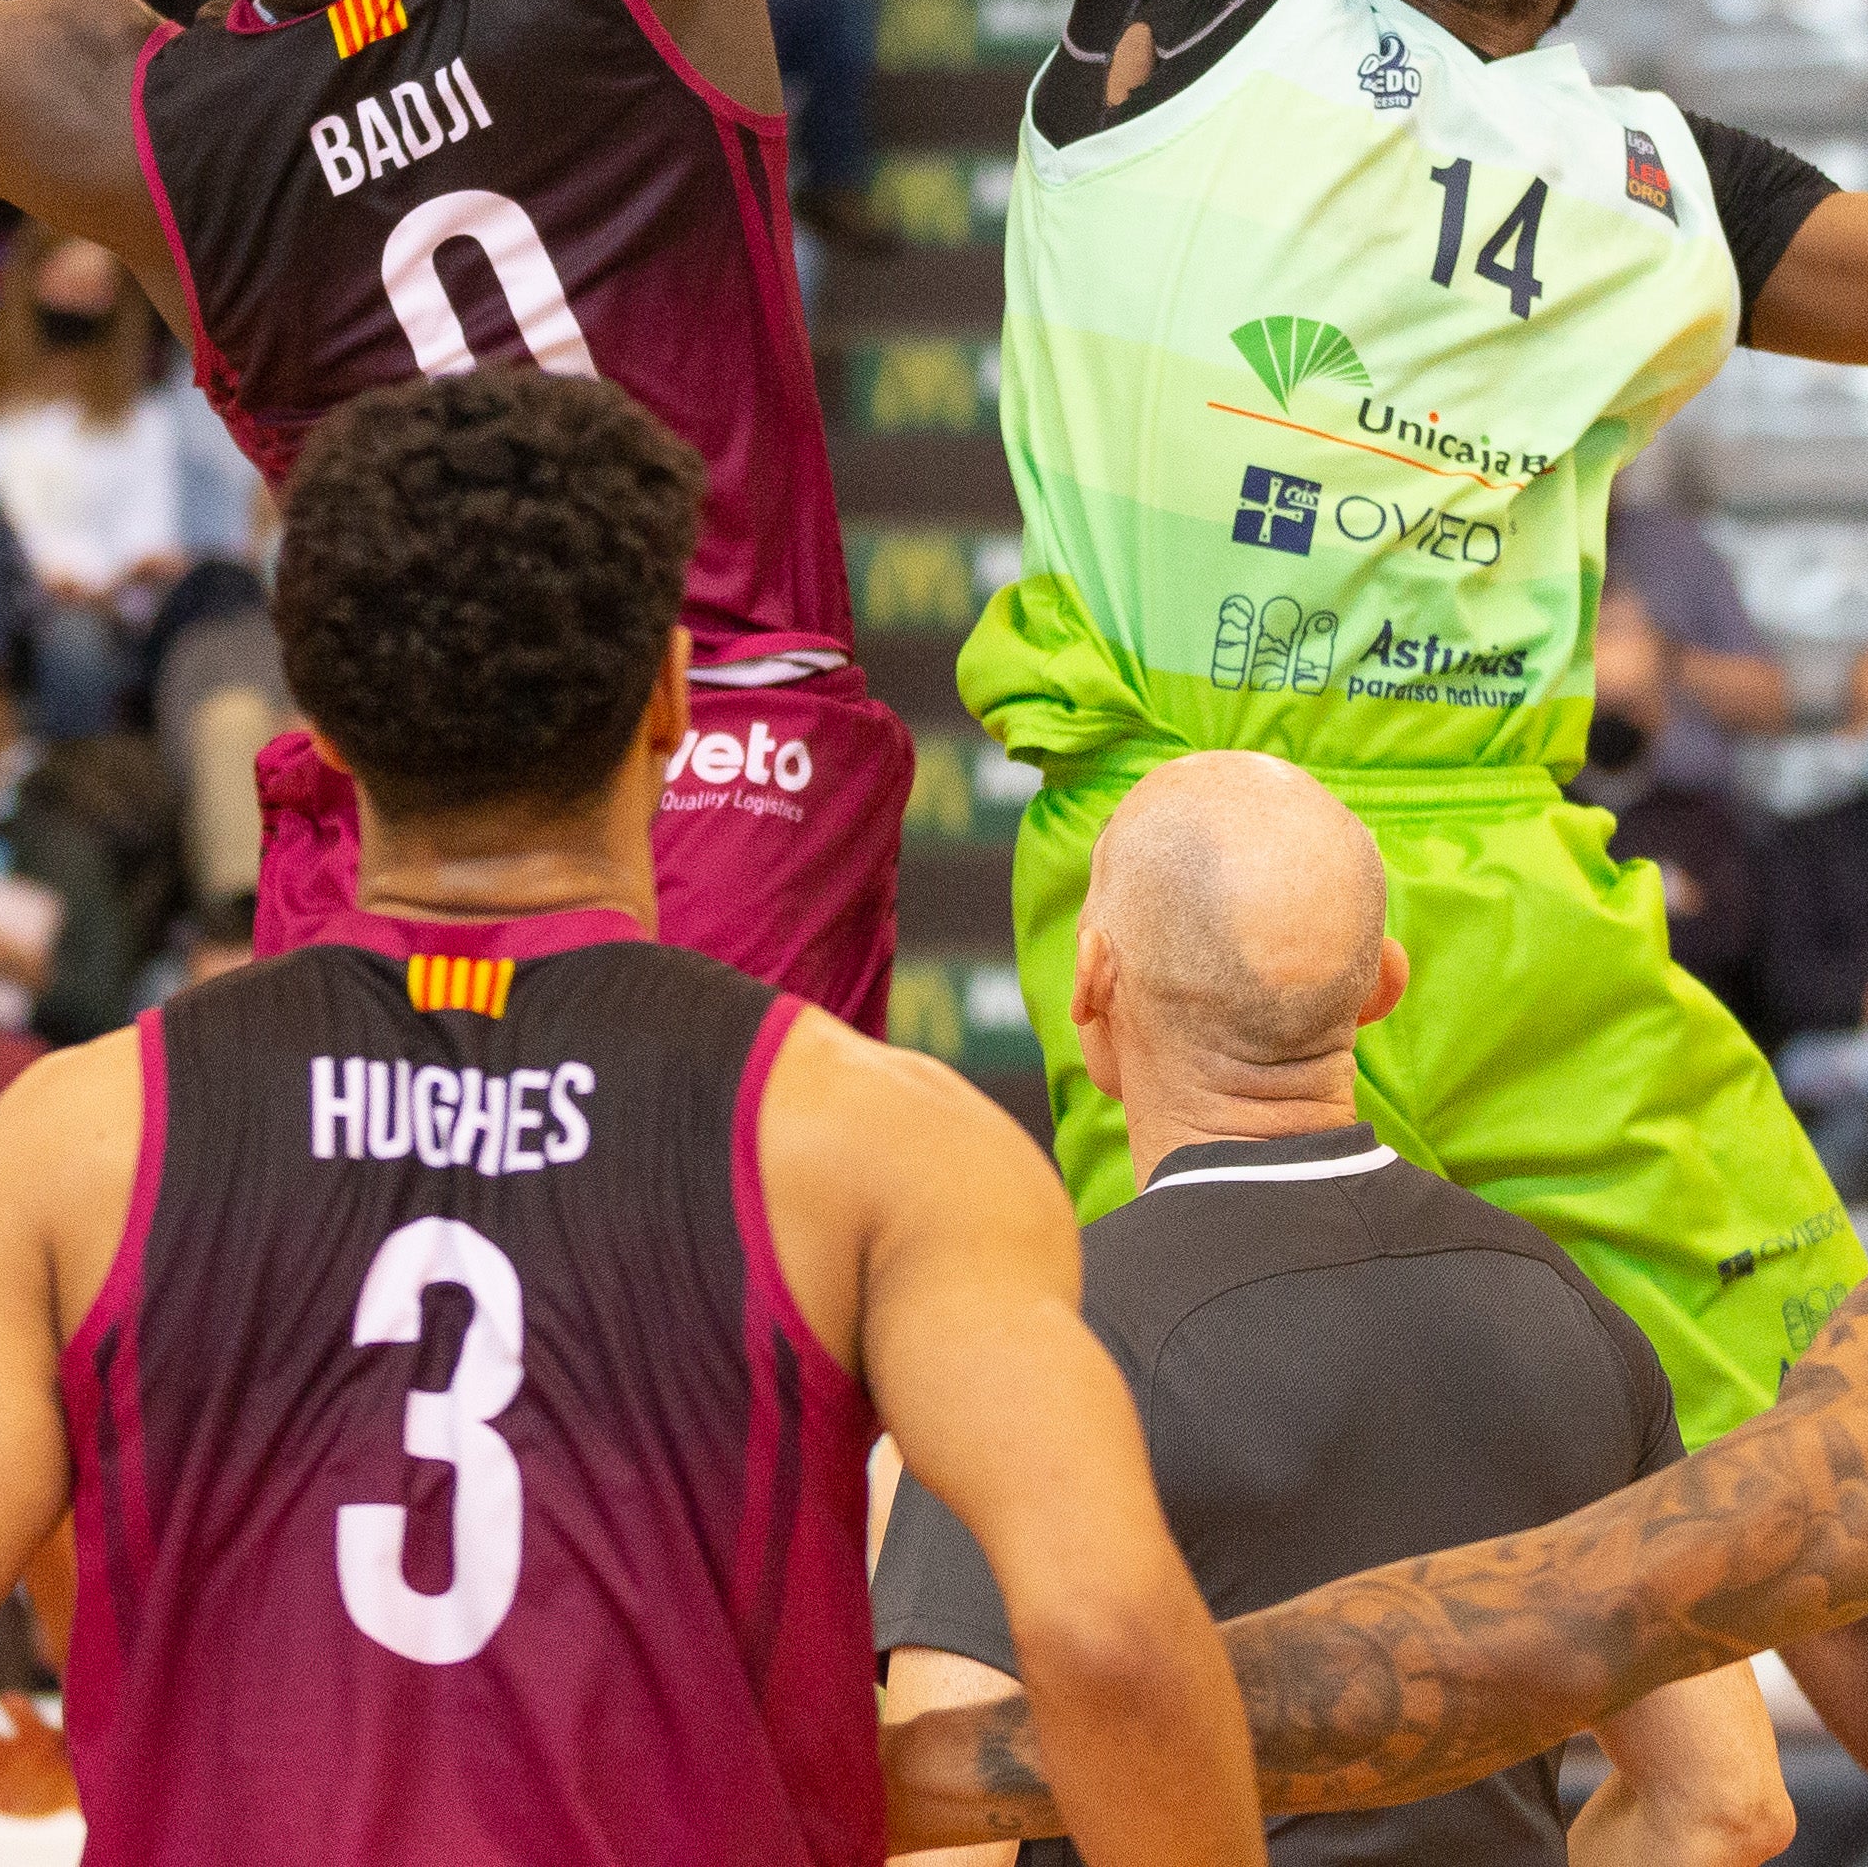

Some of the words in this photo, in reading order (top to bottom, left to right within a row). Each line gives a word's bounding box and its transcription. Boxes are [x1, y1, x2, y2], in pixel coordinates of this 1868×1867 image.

[309, 57, 493, 196] BADJI
[1430, 157, 1549, 320] 14
[1357, 396, 1512, 477] Unicaja
[1335, 494, 1503, 568] OVIED
[733, 788, 805, 824] Logistics
[310, 1055, 597, 1175] HUGHES
[335, 1215, 525, 1666] 3
